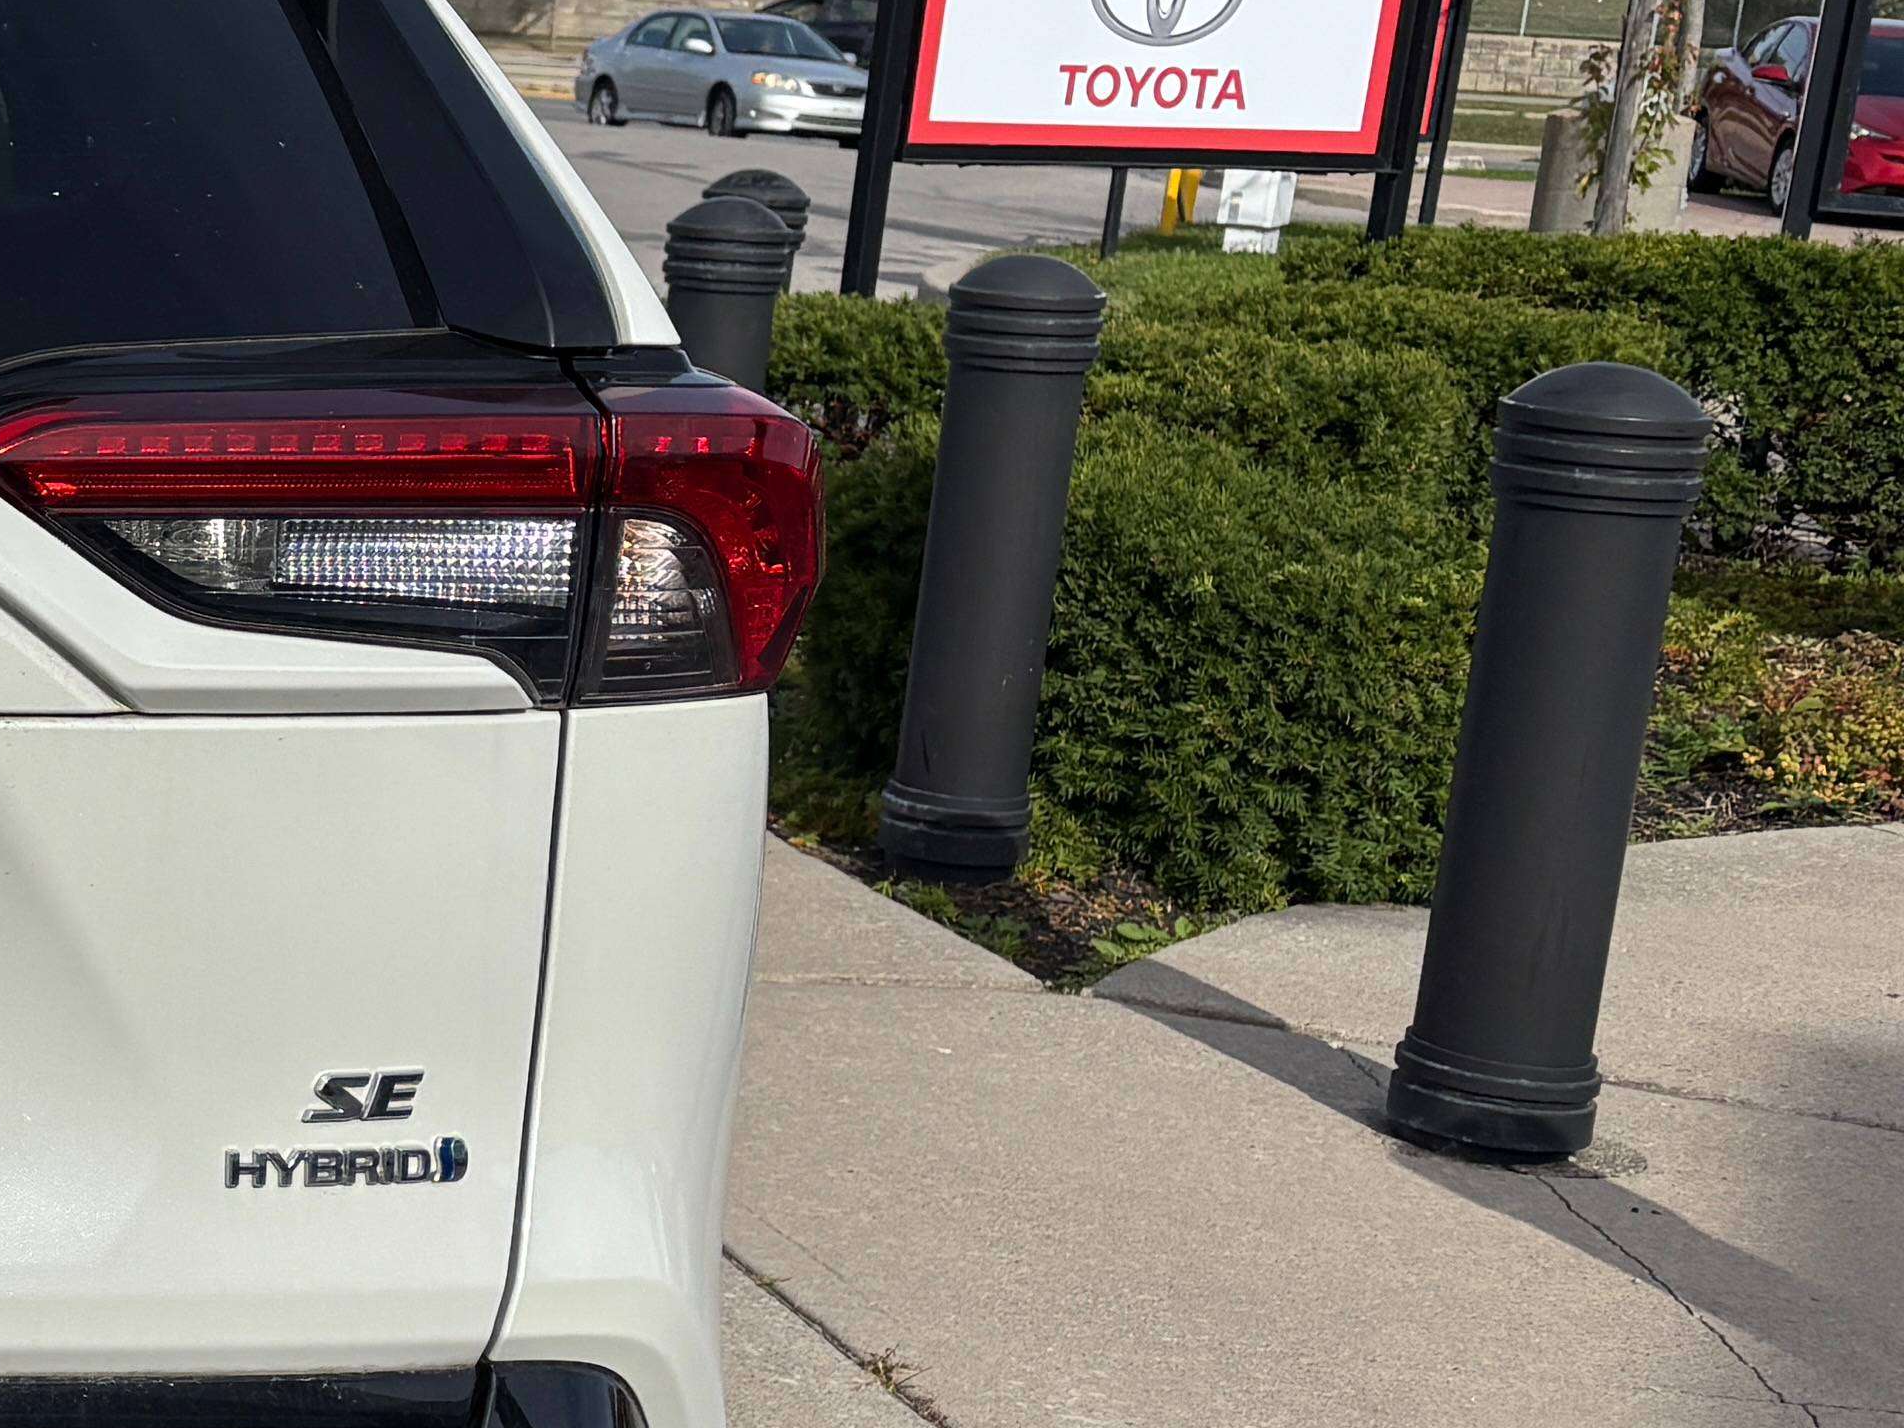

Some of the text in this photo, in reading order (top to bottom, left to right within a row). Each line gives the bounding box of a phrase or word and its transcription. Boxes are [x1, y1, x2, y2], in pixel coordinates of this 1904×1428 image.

[1059, 64, 1246, 111] TOYOTA
[300, 1066, 426, 1123] SE
[224, 1143, 432, 1189] HYBRID
